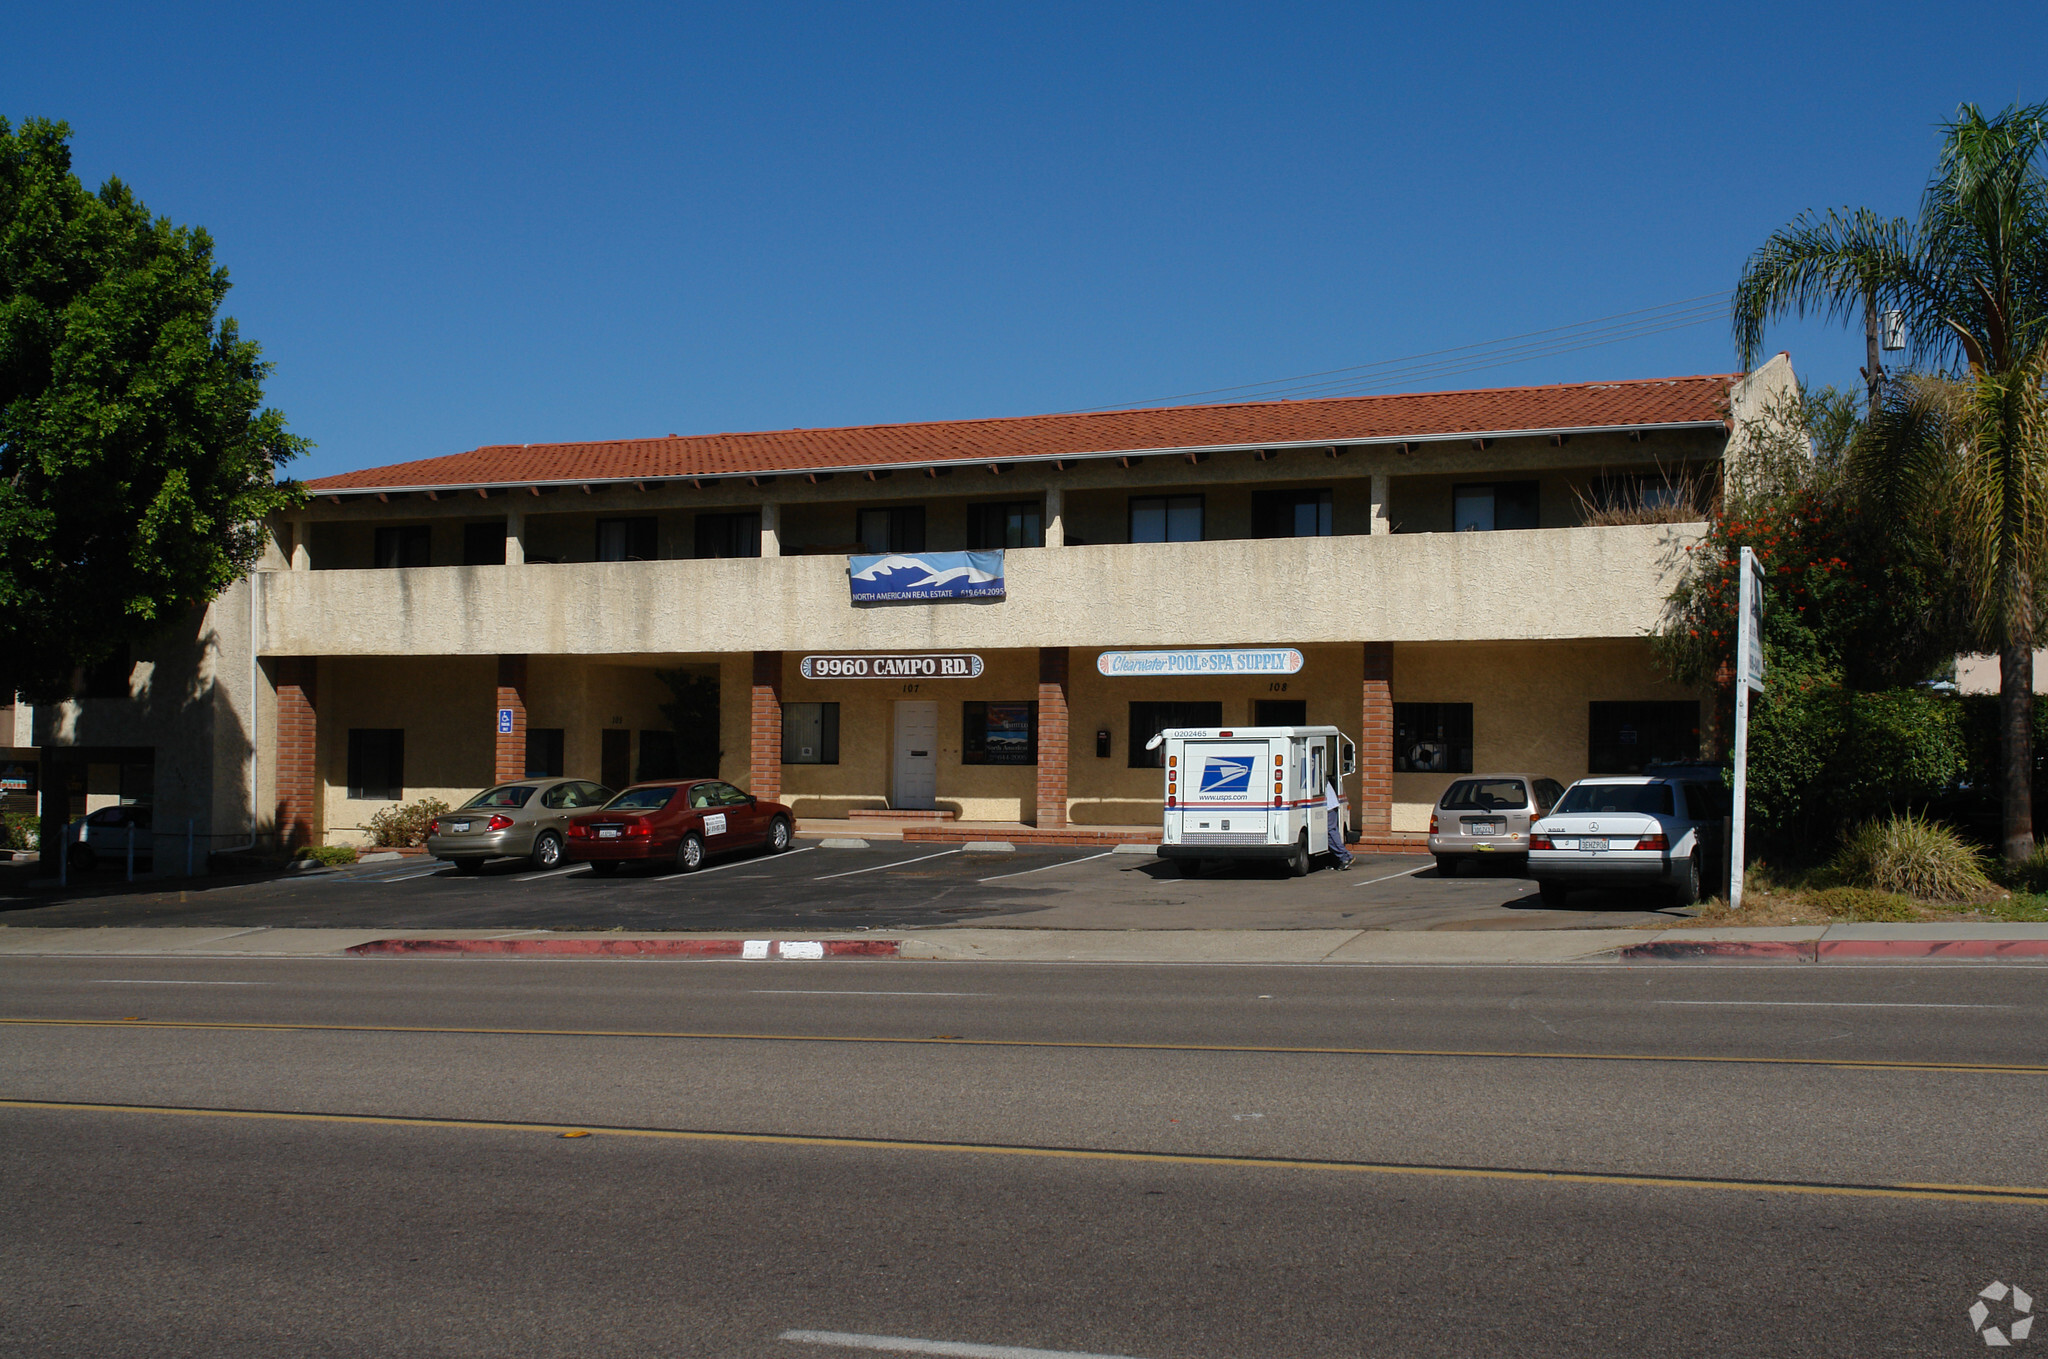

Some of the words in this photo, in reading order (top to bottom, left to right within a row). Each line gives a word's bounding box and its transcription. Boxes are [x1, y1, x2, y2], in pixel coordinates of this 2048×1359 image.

[876, 590, 912, 599] AMERICAN
[930, 590, 953, 598] ESTATE
[961, 588, 1004, 596] 619.644.2095
[816, 659, 868, 676] 9960
[873, 658, 936, 675] CAMPO
[941, 658, 969, 675] RD.
[1112, 655, 1168, 672] Clearwater
[1168, 654, 1201, 671] POOL
[1209, 654, 1234, 670] SPA
[1237, 653, 1287, 670] SUPPLY
[902, 684, 919, 693] 107
[1269, 682, 1288, 692] 108
[1582, 841, 1607, 849] 3EHZ906
